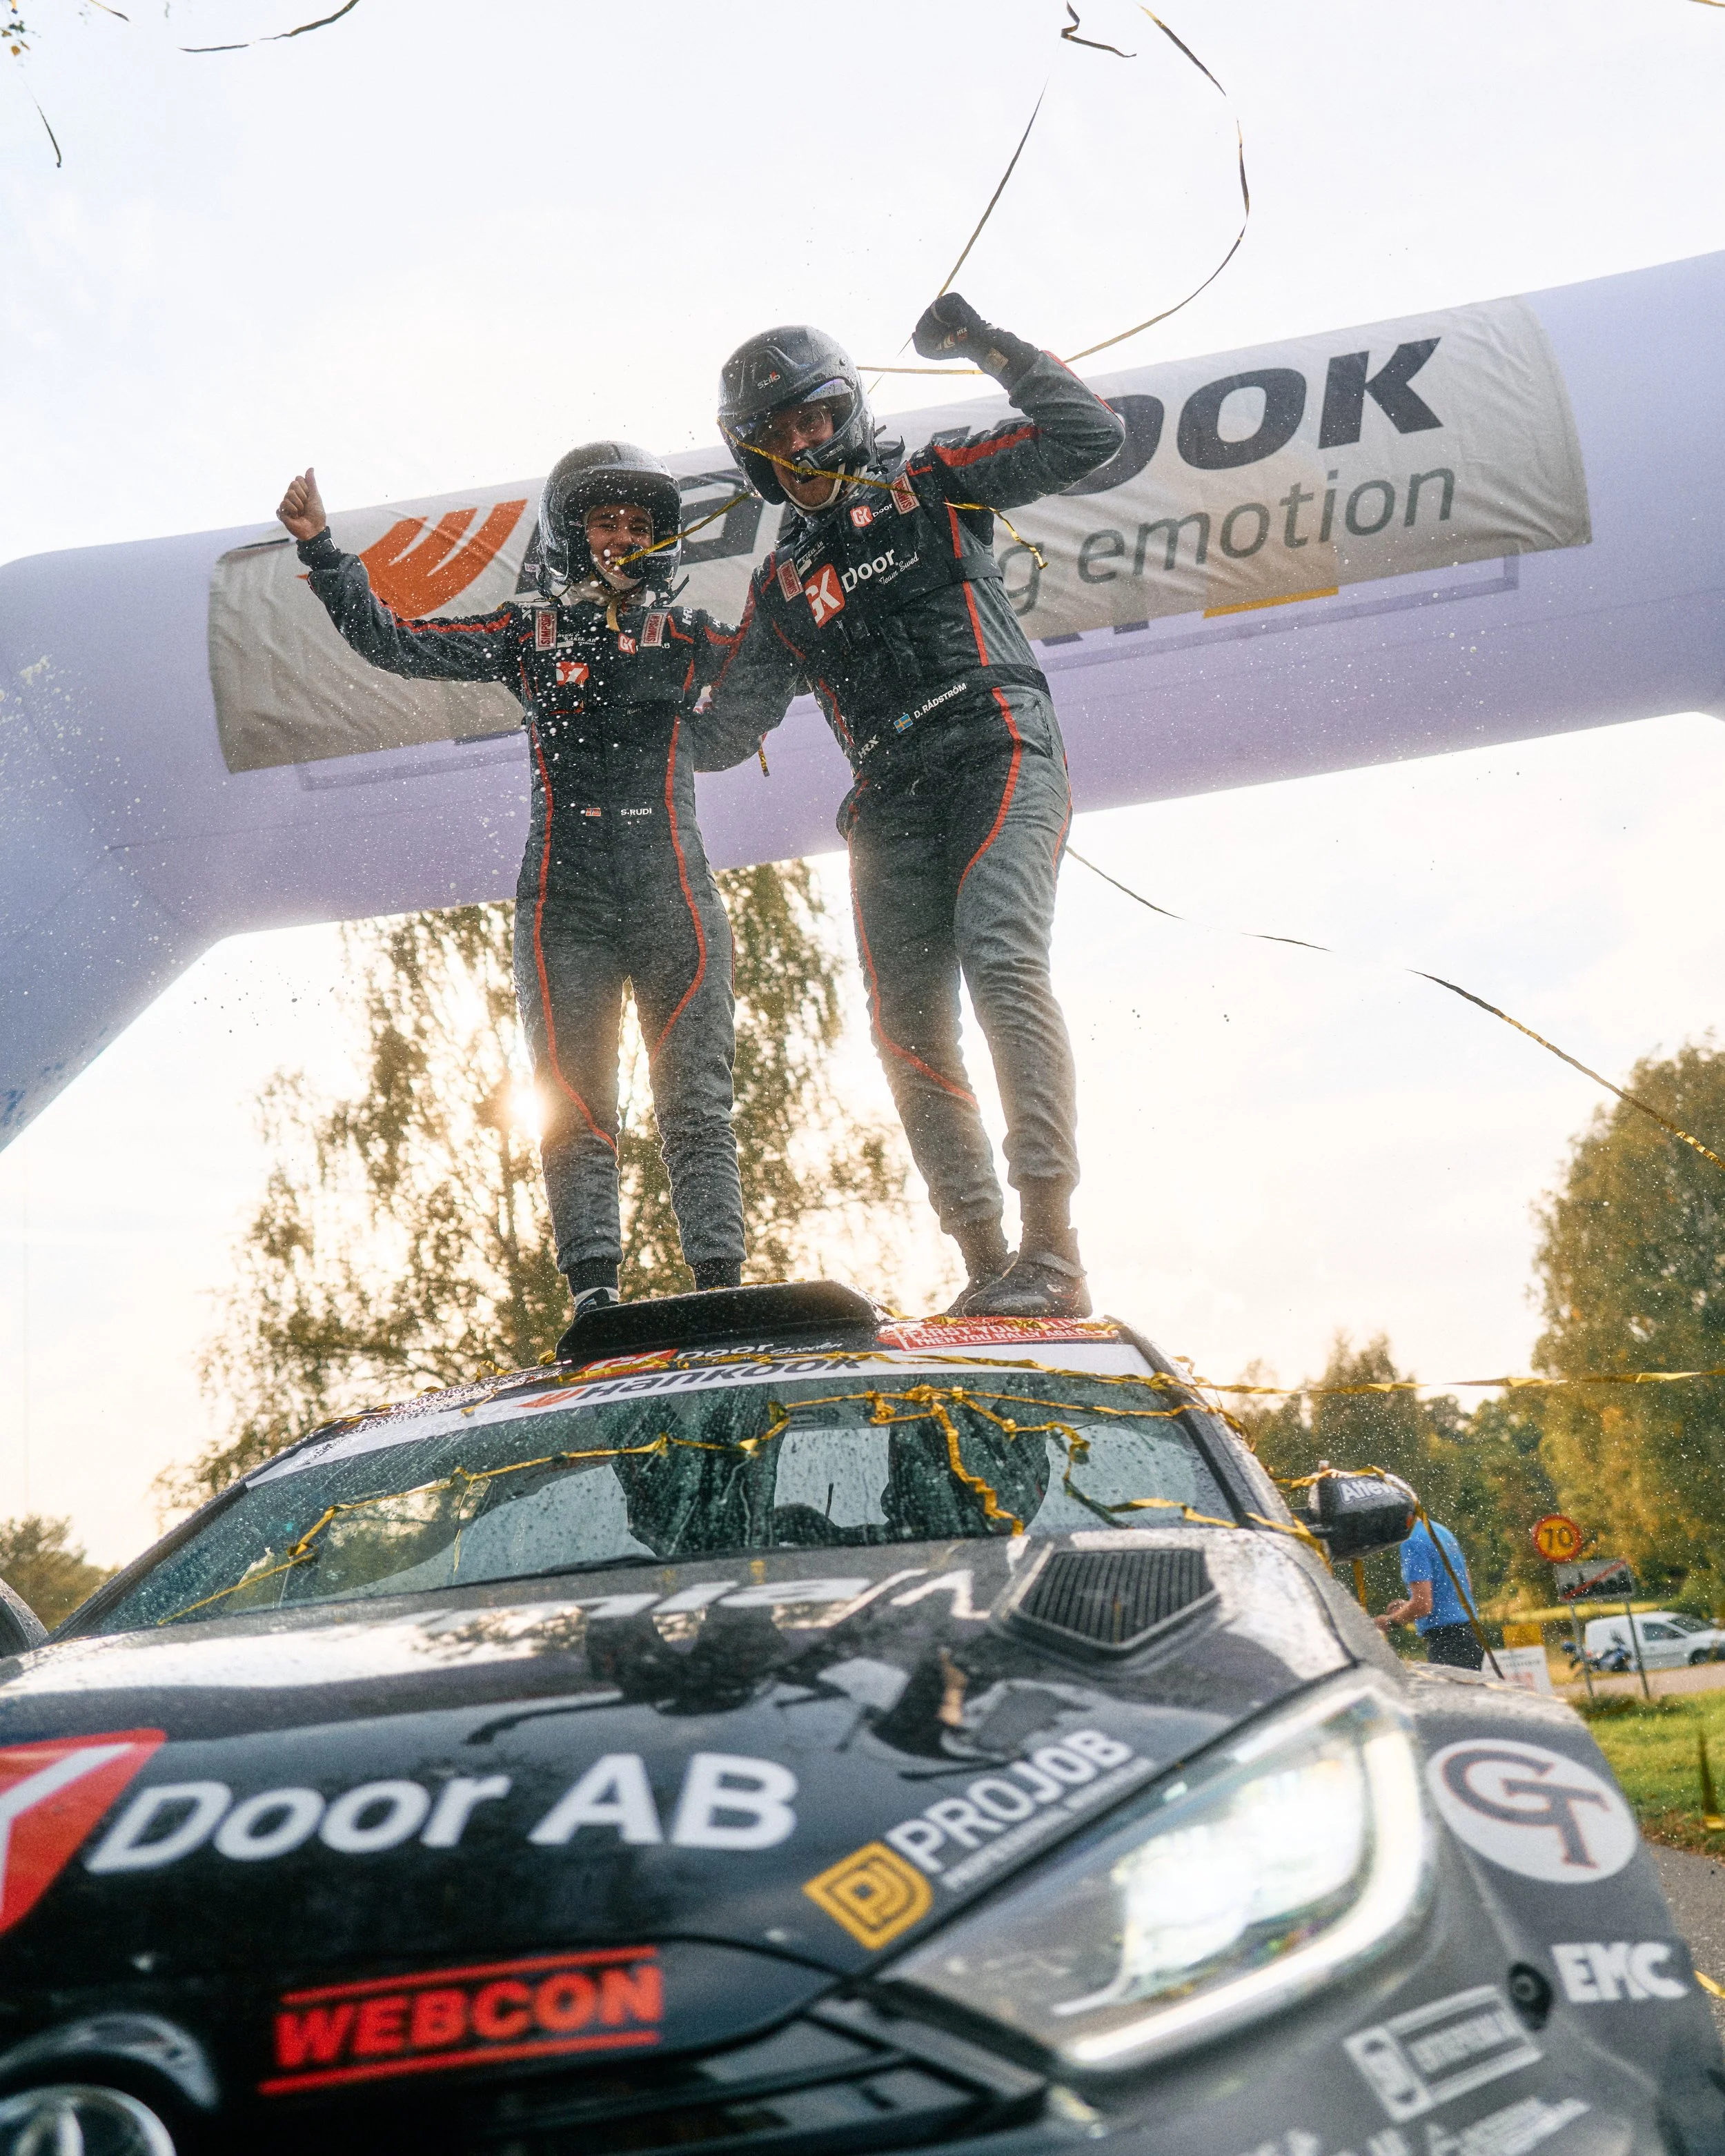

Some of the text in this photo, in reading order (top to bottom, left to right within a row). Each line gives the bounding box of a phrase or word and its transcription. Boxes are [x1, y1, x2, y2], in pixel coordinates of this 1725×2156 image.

[852, 507, 868, 525] GK
[1076, 466, 1456, 585] emotion
[840, 548, 896, 593] Door
[879, 570, 898, 586] Team
[539, 611, 551, 647] SIMPSON
[645, 613, 661, 643] SIMPSON
[858, 734, 880, 759] HRX
[907, 1325, 974, 1338] FIRST
[976, 1323, 1021, 1336] YOU
[915, 1336, 957, 1346] THEN
[958, 1332, 992, 1343] YOU
[994, 1331, 1041, 1340] RALLY
[1544, 1526, 1574, 1552] 70
[84, 1774, 512, 1875] Door
[527, 1752, 799, 1850] AB
[885, 1729, 1133, 1874] PROJOB
[1441, 1748, 1610, 1869] GT
[1552, 1941, 1690, 2001] EMC
[276, 1965, 664, 2068] WEBCON
